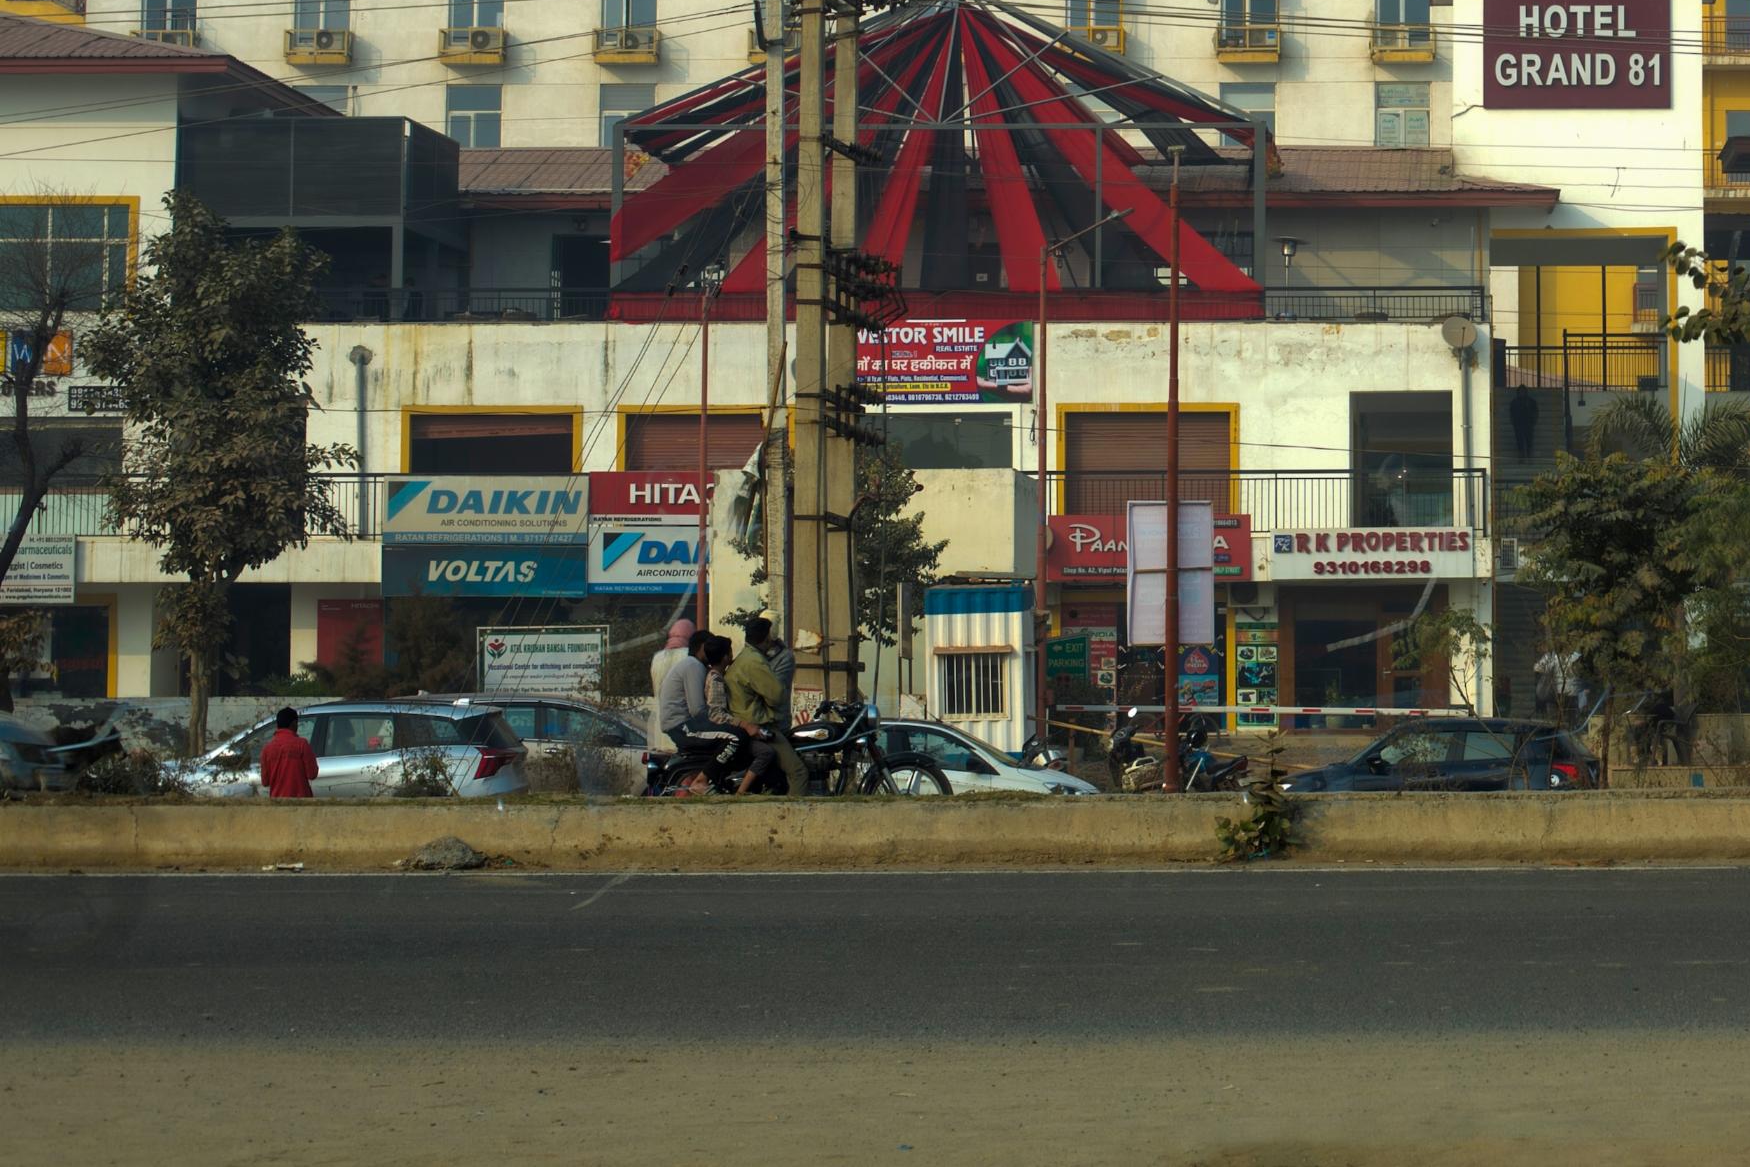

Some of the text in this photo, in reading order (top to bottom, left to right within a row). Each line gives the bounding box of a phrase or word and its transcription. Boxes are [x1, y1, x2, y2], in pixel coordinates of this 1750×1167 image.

[1519, 4, 1637, 38] HOTEL
[1494, 52, 1661, 87] GRAND 81
[932, 326, 985, 344] SMILE
[935, 345, 953, 353] REAL
[891, 358, 908, 371] घर
[910, 354, 958, 372] हकीकत
[426, 489, 583, 515] DAIKIN
[440, 519, 568, 528] AIR CONDITIONING SOLUTIONS
[395, 534, 424, 542] RATAN
[426, 533, 503, 542] REFRIGERATIONS
[1296, 531, 1470, 554] R K PROPERTIES
[30, 561, 64, 570] Cosmetics
[428, 560, 538, 583] VOLTAS
[1313, 560, 1432, 575] 9310168298
[1065, 643, 1083, 653] EXIT
[1048, 659, 1084, 668] PARKING
